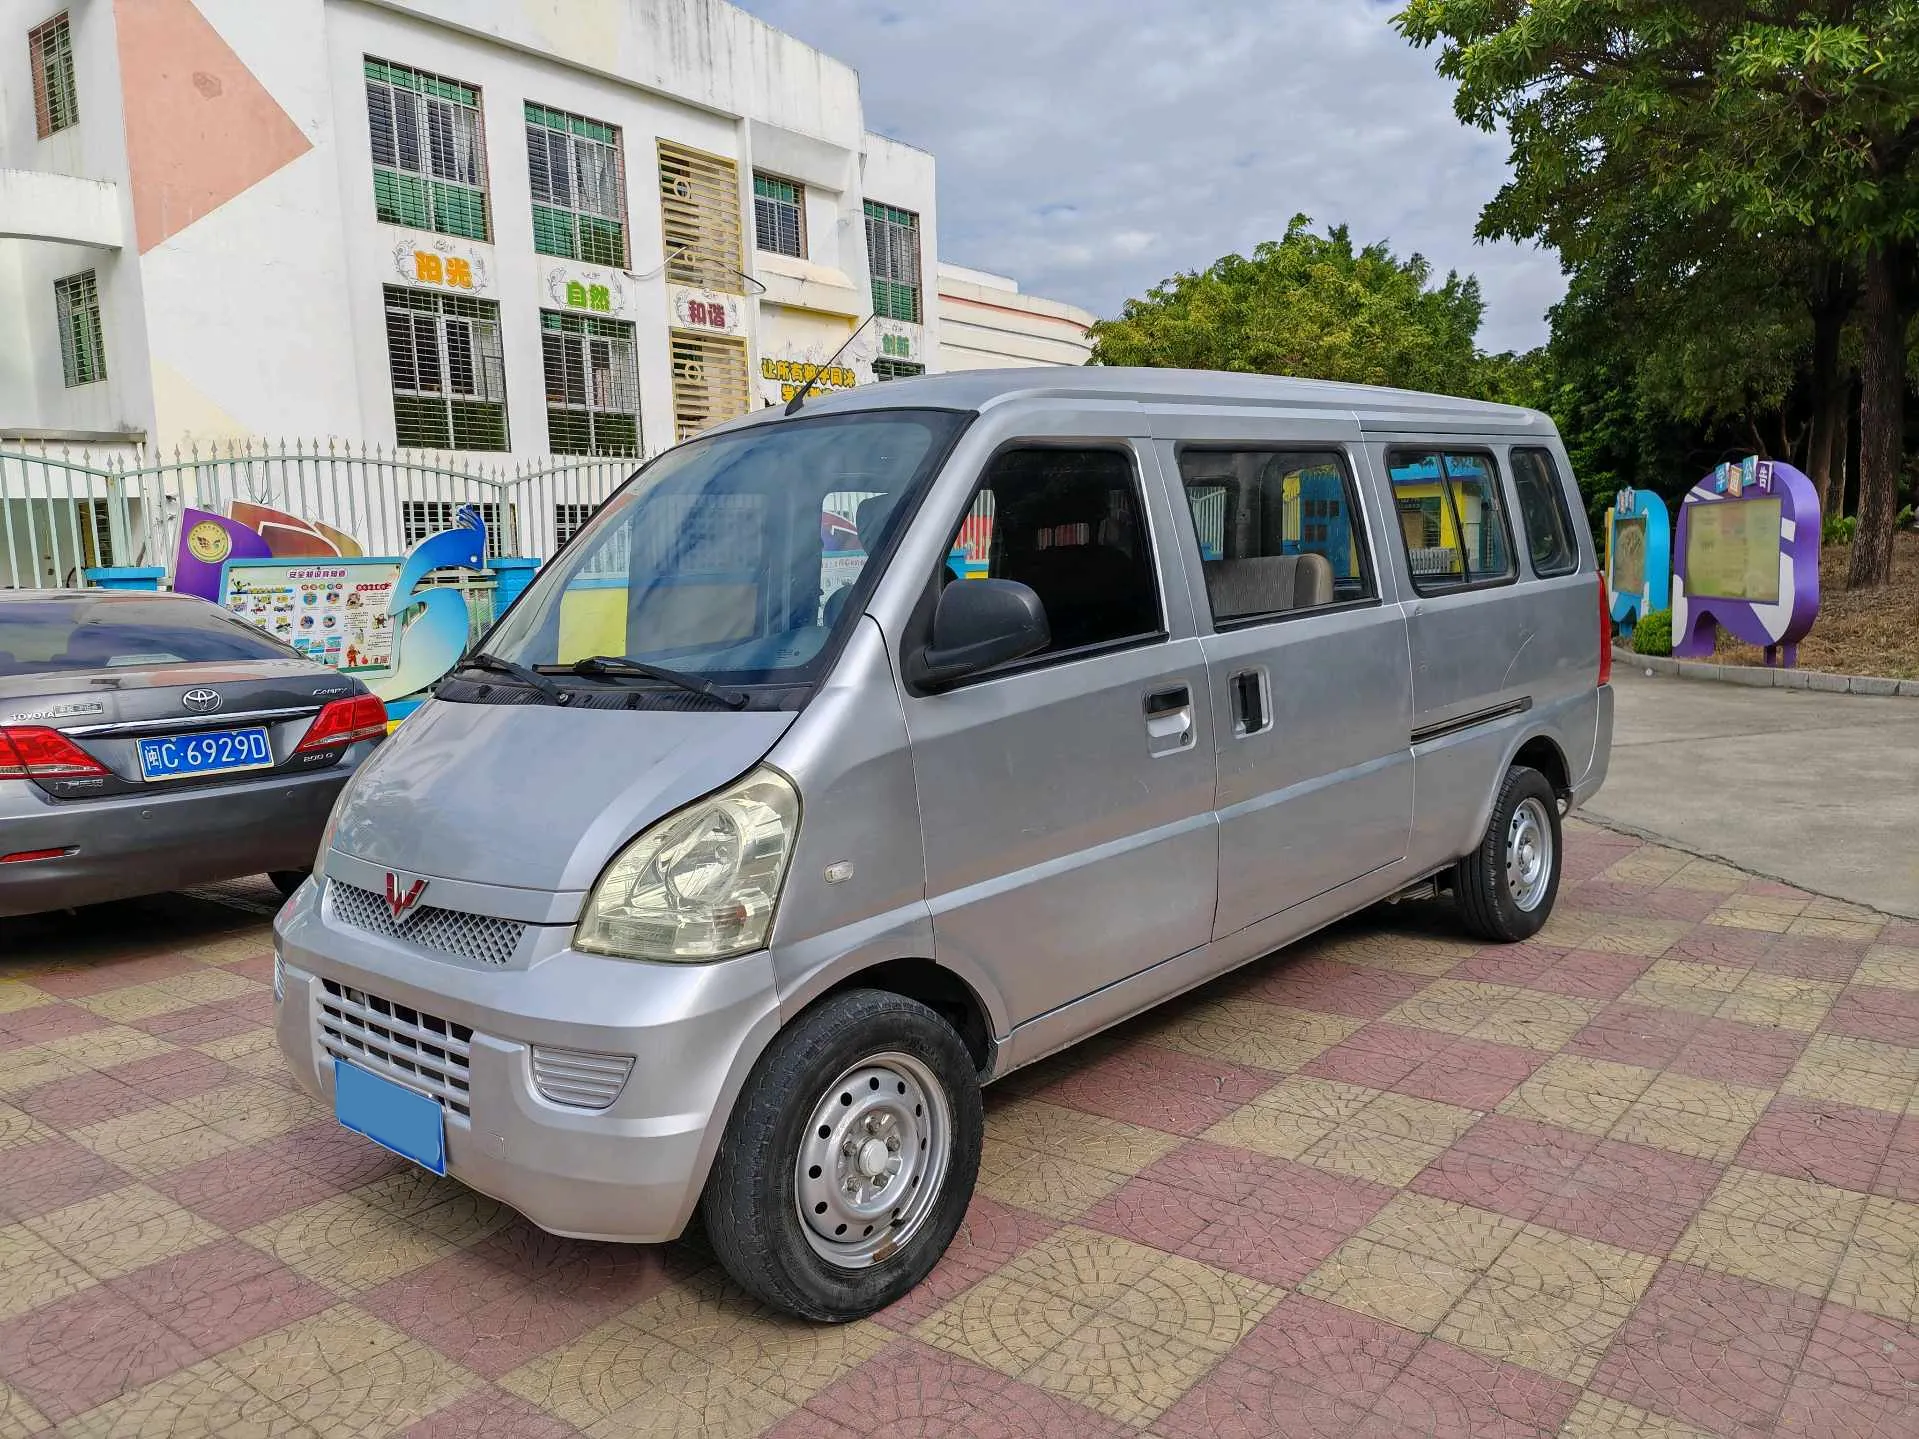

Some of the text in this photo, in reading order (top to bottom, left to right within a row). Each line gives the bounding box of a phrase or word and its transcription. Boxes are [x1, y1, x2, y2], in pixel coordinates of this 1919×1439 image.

[414, 250, 473, 289] 阳光
[565, 280, 611, 311] 自然
[687, 300, 727, 329] 和谐
[10, 711, 56, 721] TOYOTA
